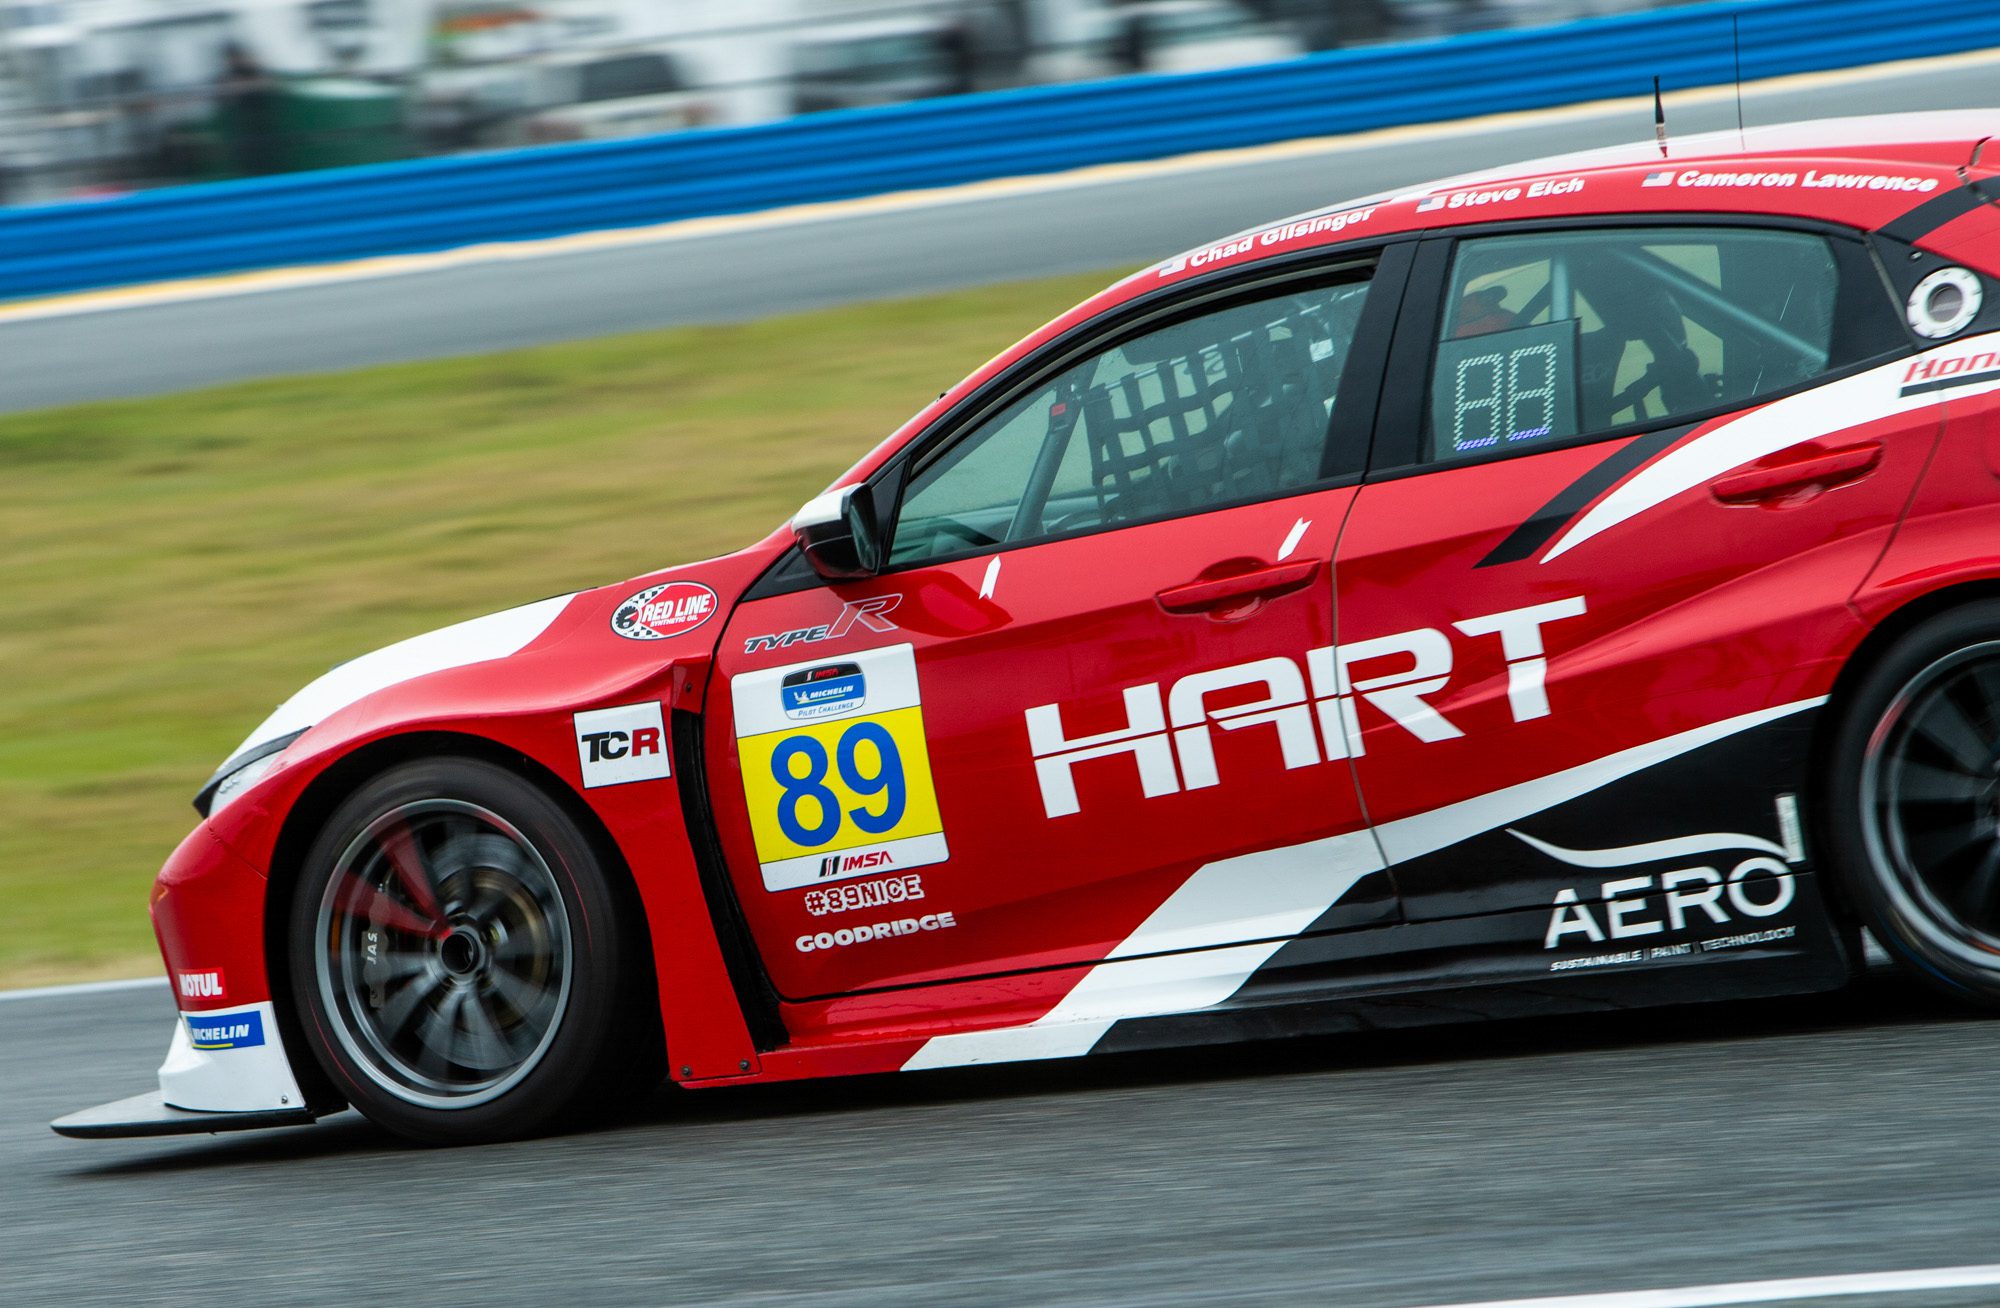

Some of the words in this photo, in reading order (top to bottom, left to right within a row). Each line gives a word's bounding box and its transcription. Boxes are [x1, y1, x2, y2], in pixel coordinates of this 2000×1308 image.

[1447, 187, 1521, 209] Steve
[1526, 177, 1586, 199] Eich
[1677, 170, 1798, 188] Cameron
[1800, 170, 1940, 193] Lawrence
[1190, 235, 1254, 267] Chad
[1902, 352, 2000, 384] Hon
[641, 600, 675, 624] RED
[649, 614, 686, 628] SYNTHETIC
[686, 613, 699, 622] OIL
[744, 624, 830, 654] TYPE
[825, 593, 903, 640] R
[809, 684, 855, 700] MICHELIN
[1025, 595, 1587, 819] HART
[581, 726, 661, 763] TCR
[770, 721, 907, 847] 89
[842, 850, 894, 873] IMSA
[804, 873, 926, 917] #89NICE
[1544, 856, 1796, 950] AERO
[367, 931, 378, 965] JAS
[795, 911, 957, 953] GOODRIDGE
[1550, 949, 1643, 972] SUSTAINABLE
[1650, 943, 1693, 960] PAINT
[1699, 925, 1797, 952] TECHNOLOGY
[178, 971, 223, 997] MOTUL
